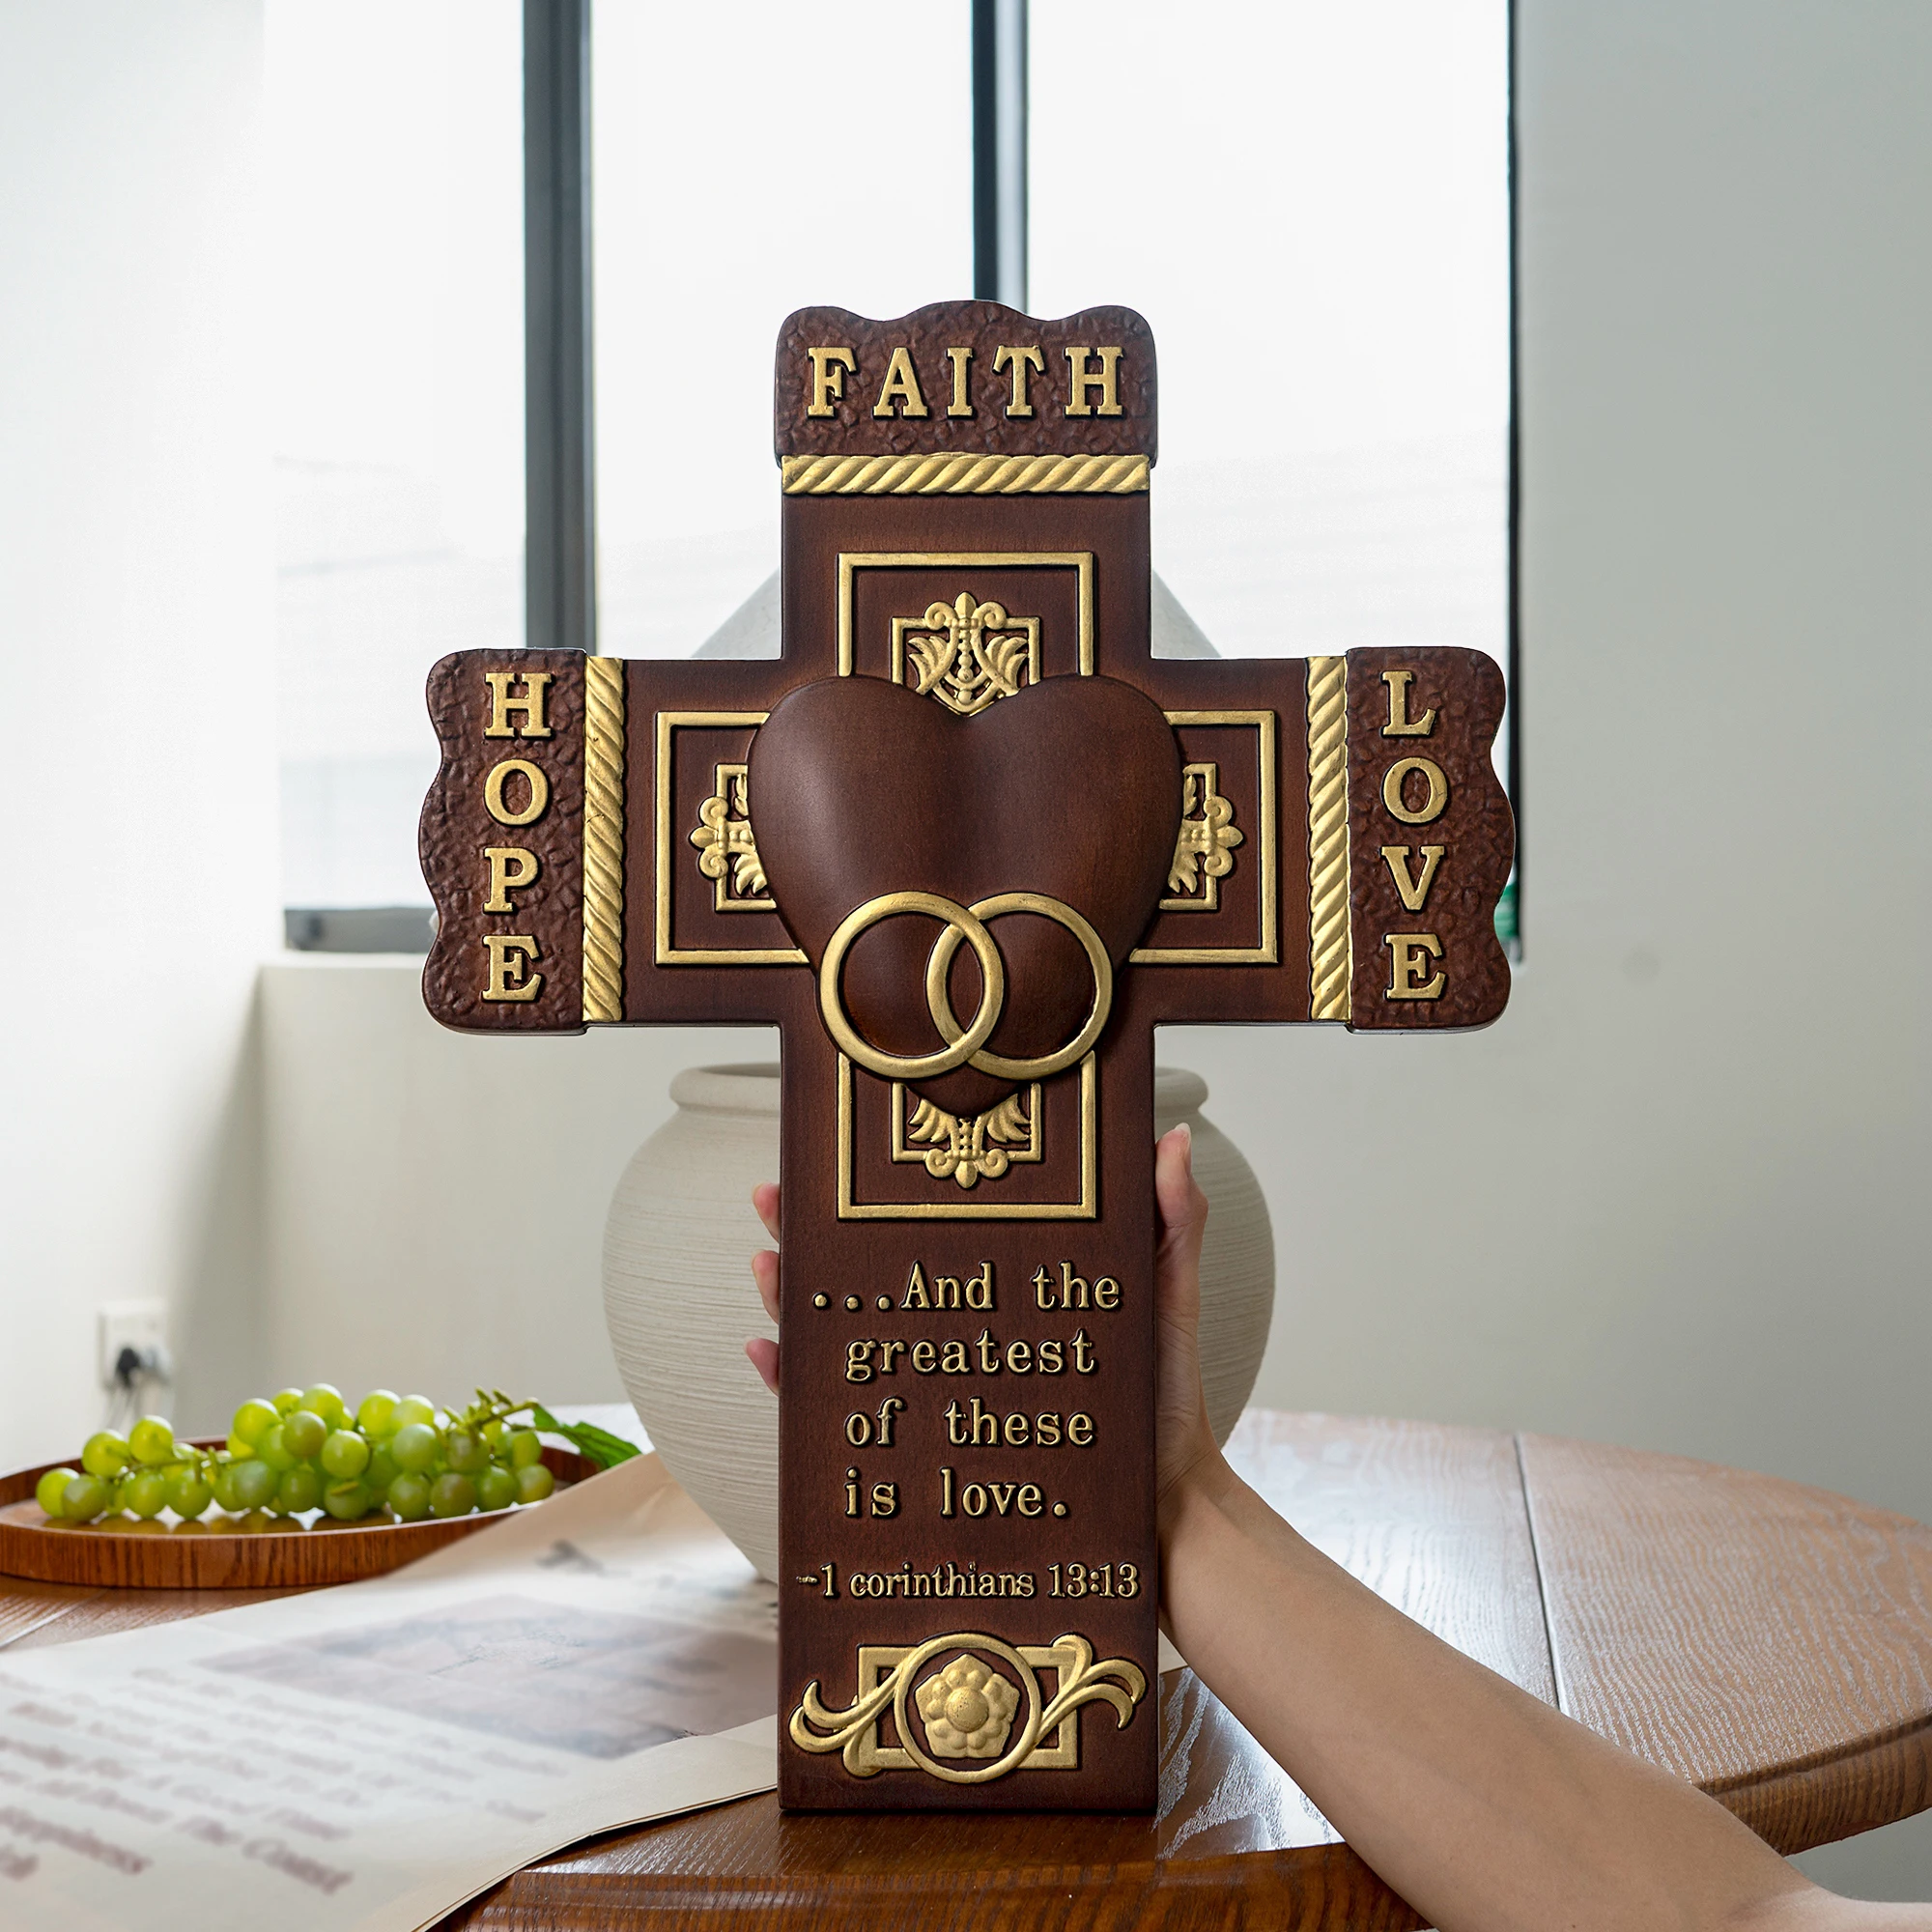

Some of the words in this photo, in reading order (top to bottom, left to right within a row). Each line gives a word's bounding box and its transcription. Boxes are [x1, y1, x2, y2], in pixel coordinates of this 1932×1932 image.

[808, 346, 1123, 417] FAITH
[482, 671, 553, 1002] HOPE
[1380, 670, 1449, 1000] LOVE
[1032, 1261, 1120, 1310] the
[844, 1328, 1094, 1381] greatest
[845, 1397, 903, 1445] of
[945, 1397, 1094, 1445] these
[844, 1467, 895, 1516] is
[940, 1467, 1066, 1516] love.
[850, 1561, 1035, 1598] corinthians
[1048, 1562, 1139, 1598] 13:13
